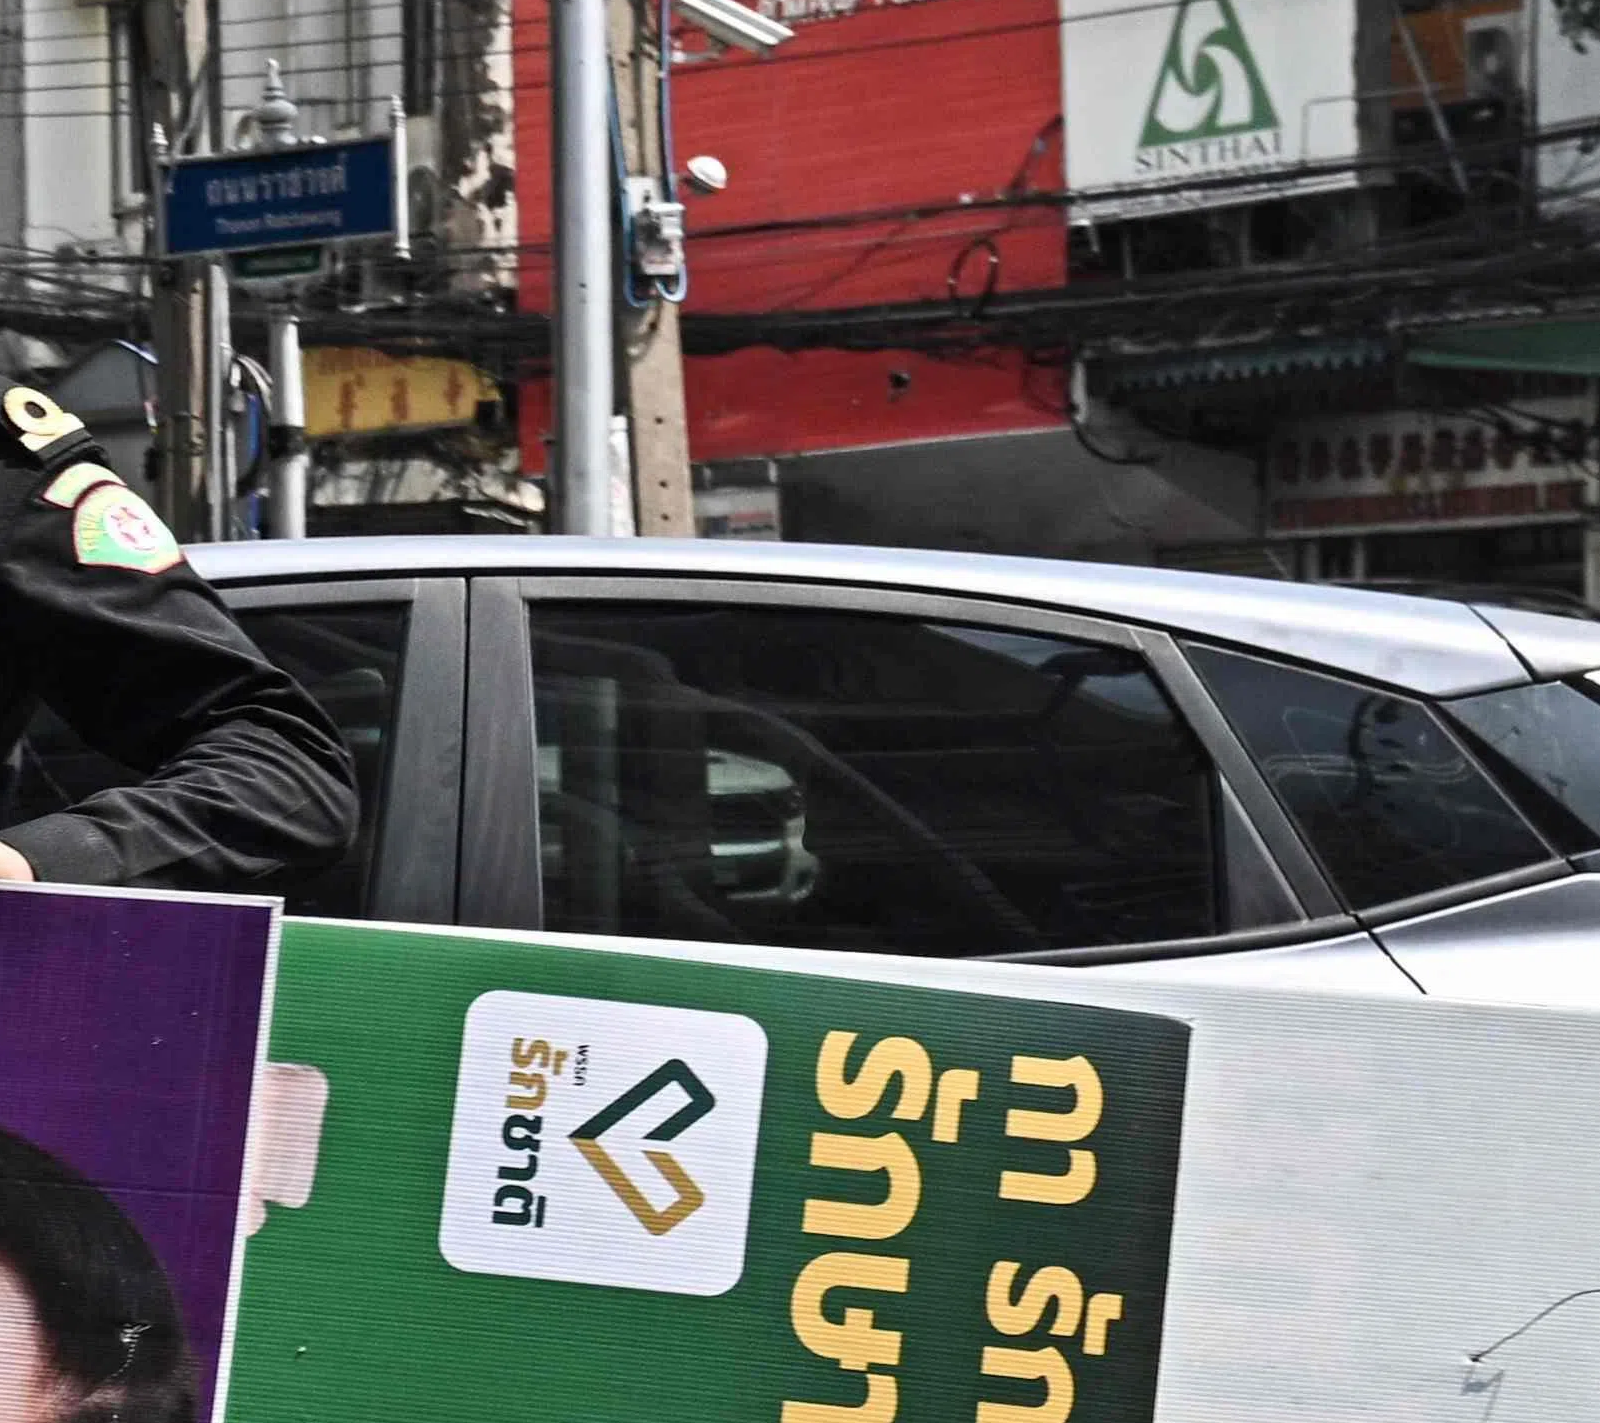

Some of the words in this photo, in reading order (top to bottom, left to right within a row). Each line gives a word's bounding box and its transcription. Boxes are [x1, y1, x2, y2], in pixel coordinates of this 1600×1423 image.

[1135, 131, 1281, 175] SINTHAI
[573, 1044, 590, 1086] พรรค
[492, 1037, 571, 1228] รักชาติ
[998, 1055, 1104, 1205] กา
